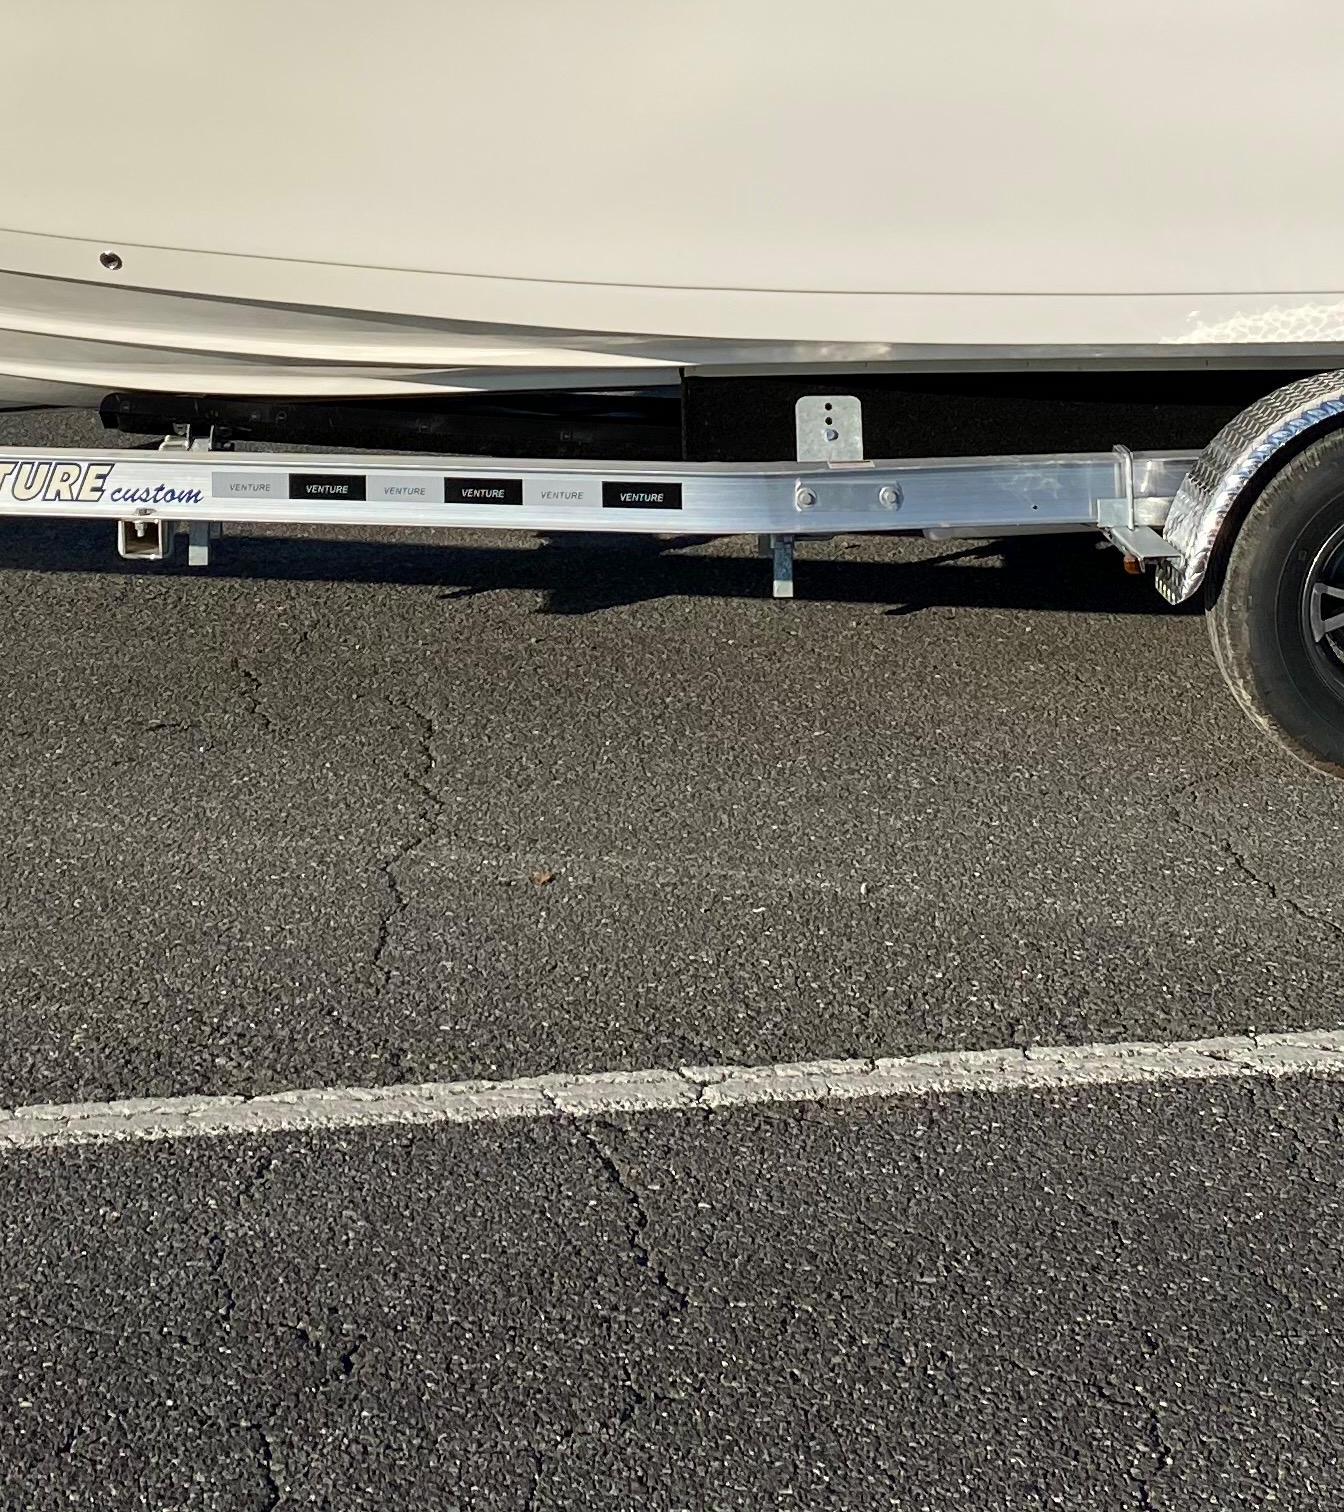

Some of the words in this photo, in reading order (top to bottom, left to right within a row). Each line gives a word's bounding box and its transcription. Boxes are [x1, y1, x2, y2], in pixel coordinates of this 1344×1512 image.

[110, 483, 204, 504] custom
[229, 483, 271, 492] VENTURE
[306, 484, 348, 494] VENTURE
[384, 486, 426, 495] VENTURE
[461, 489, 505, 498] VENTURE
[541, 491, 584, 500] VENTURE
[620, 492, 664, 502] VENTURE
